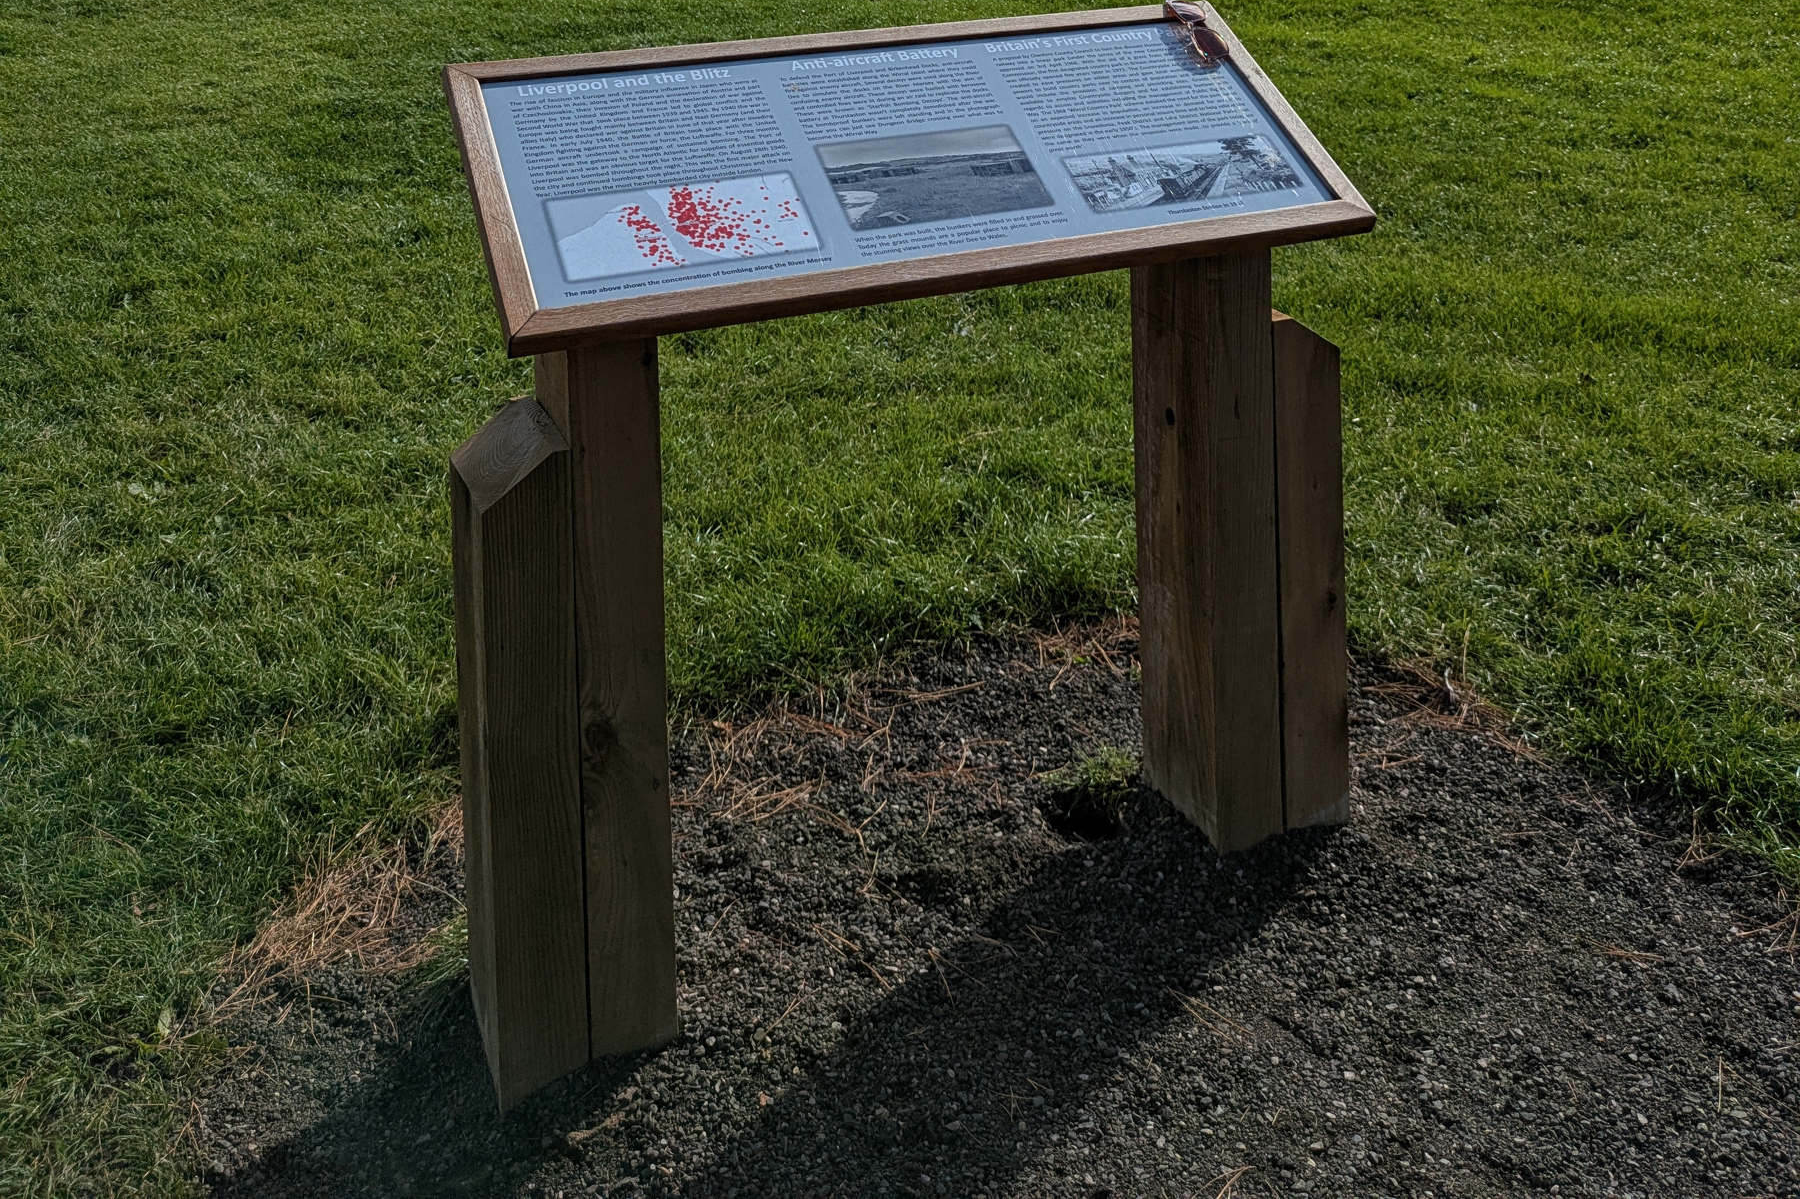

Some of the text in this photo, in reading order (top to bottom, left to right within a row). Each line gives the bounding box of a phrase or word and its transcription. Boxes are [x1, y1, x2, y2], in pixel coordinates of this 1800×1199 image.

[984, 26, 1188, 52] Britain's First Country Park
[791, 48, 958, 71] Anti-aircraft Battery
[517, 68, 731, 96] Liverpool and the Blitz
[531, 175, 564, 184] Liverpool
[580, 170, 610, 179] bombed
[610, 166, 649, 175] throughout
[553, 187, 586, 196] Liverpool
[658, 174, 697, 184] bombarded
[575, 177, 610, 186] continued
[610, 174, 645, 182] bombings
[681, 165, 719, 174] throughout
[719, 162, 752, 170] Christmas
[887, 231, 903, 239] park
[945, 223, 972, 231] bunkers
[1025, 211, 1049, 221] grassed
[910, 234, 937, 243] mounds
[956, 229, 981, 237] popular
[982, 226, 999, 234] place
[1009, 222, 1028, 230] picnic
[873, 247, 902, 255] stunning
[598, 285, 621, 293] above
[622, 281, 647, 289] shows
[661, 272, 712, 284] concentration
[720, 267, 753, 275] bombing
[805, 256, 832, 264] Mersey
